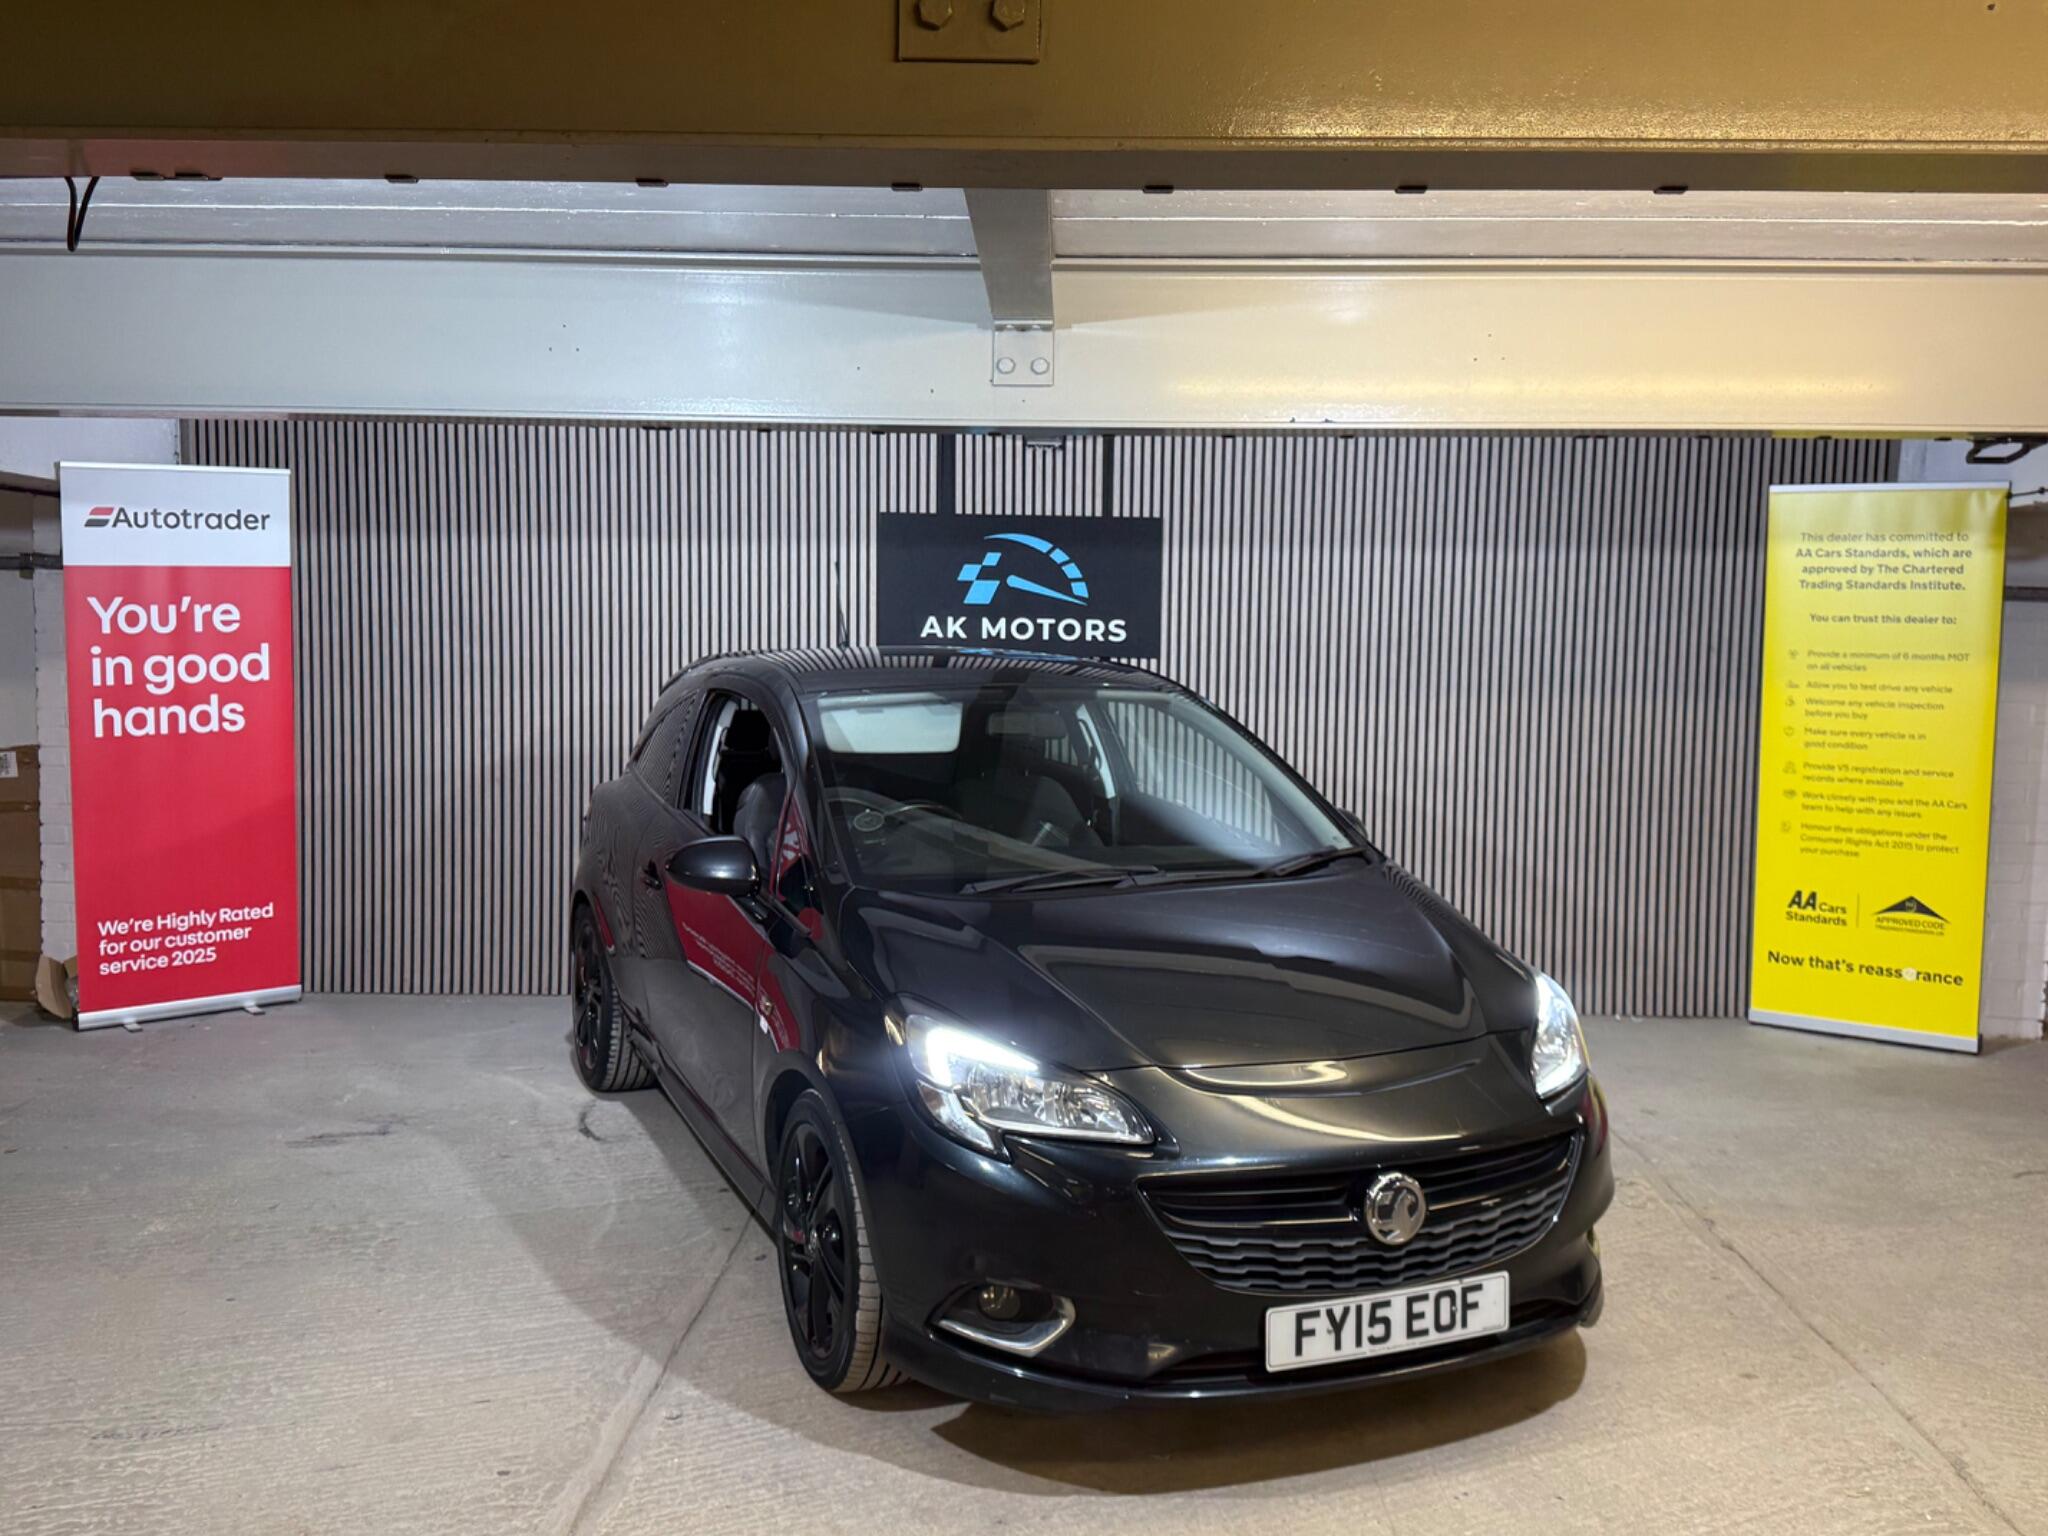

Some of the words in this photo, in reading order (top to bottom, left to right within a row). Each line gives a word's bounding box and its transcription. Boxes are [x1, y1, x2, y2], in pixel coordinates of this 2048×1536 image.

[112, 507, 270, 530] Autotrader
[1801, 533, 1825, 542] This
[1827, 533, 1862, 542] dealer
[1866, 533, 1886, 542] has
[1889, 533, 1953, 542] committed
[1957, 534, 1969, 542] to
[1796, 549, 1812, 557] AA
[1816, 549, 1842, 558] Cars
[1845, 549, 1910, 559] Standards,
[1913, 550, 1949, 558] which
[1802, 565, 1856, 574] approved
[1860, 565, 1873, 575] by
[1877, 565, 1899, 573] The
[1902, 565, 1964, 574] Chartered
[1799, 580, 1842, 590] Trading
[1846, 580, 1906, 590] Standards
[1910, 581, 1966, 590] Institute.
[920, 616, 967, 638] AK
[982, 618, 1127, 642] MOTORS
[1810, 614, 1829, 623] You
[1832, 615, 1850, 623] can
[1853, 615, 1878, 623] trust
[1881, 615, 1901, 624] this
[1904, 615, 1938, 625] dealer
[1942, 616, 1957, 625] to:
[1807, 650, 1840, 659] Provide
[1850, 651, 1890, 660] minimum
[1892, 652, 1901, 660] of
[1903, 652, 1909, 660] 6
[1911, 653, 1945, 661] months
[1948, 653, 1970, 662] MOT
[90, 646, 133, 686] in
[144, 643, 270, 694] good
[94, 694, 245, 737] hands
[1788, 890, 1817, 911] AA
[1819, 902, 1847, 915] Cars
[157, 910, 217, 931] Highly
[219, 903, 274, 922] Rated
[1786, 911, 1847, 927] Standards
[1876, 917, 1921, 929] APPROVED
[1921, 921, 1945, 930] CODE
[99, 940, 127, 955] for
[130, 936, 162, 953] our
[165, 927, 252, 948] customer
[100, 955, 168, 975] service
[172, 947, 216, 966] 2025
[1768, 951, 1804, 967] Now
[1859, 963, 1963, 986] reassrance
[1295, 1300, 1391, 1357] FY15
[1406, 1283, 1483, 1340] EOF
